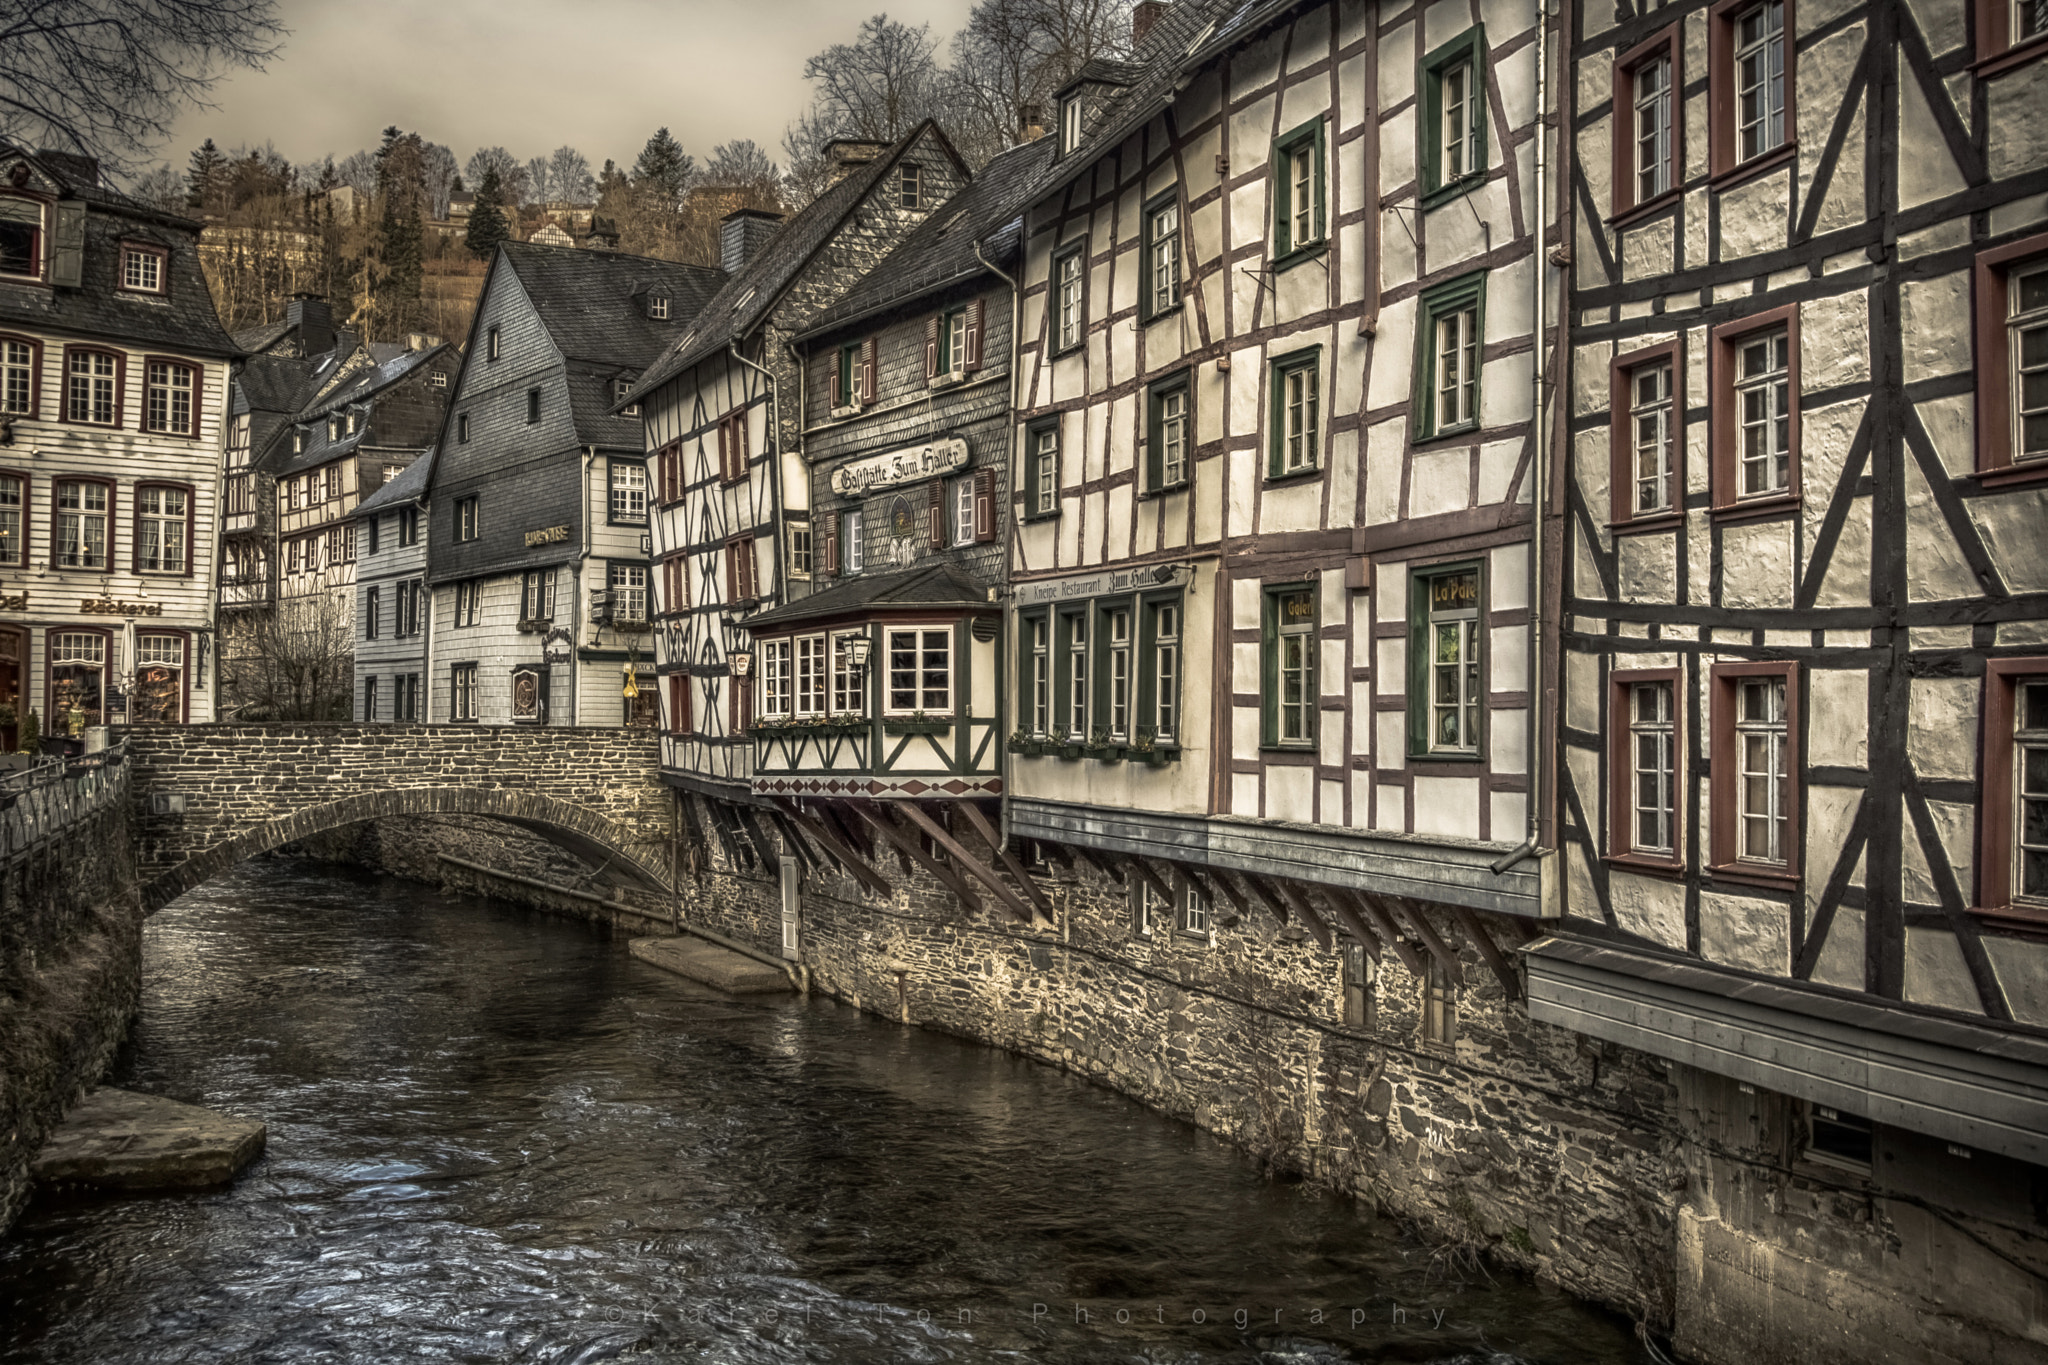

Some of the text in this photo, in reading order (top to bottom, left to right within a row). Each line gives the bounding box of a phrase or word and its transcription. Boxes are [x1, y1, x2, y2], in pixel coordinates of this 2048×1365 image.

[841, 464, 887, 490] Gaststätte
[1034, 584, 1057, 600] Kneipe
[1061, 578, 1101, 597] Restaurant
[1435, 584, 1448, 602] La
[80, 599, 163, 616] Bäckerei
